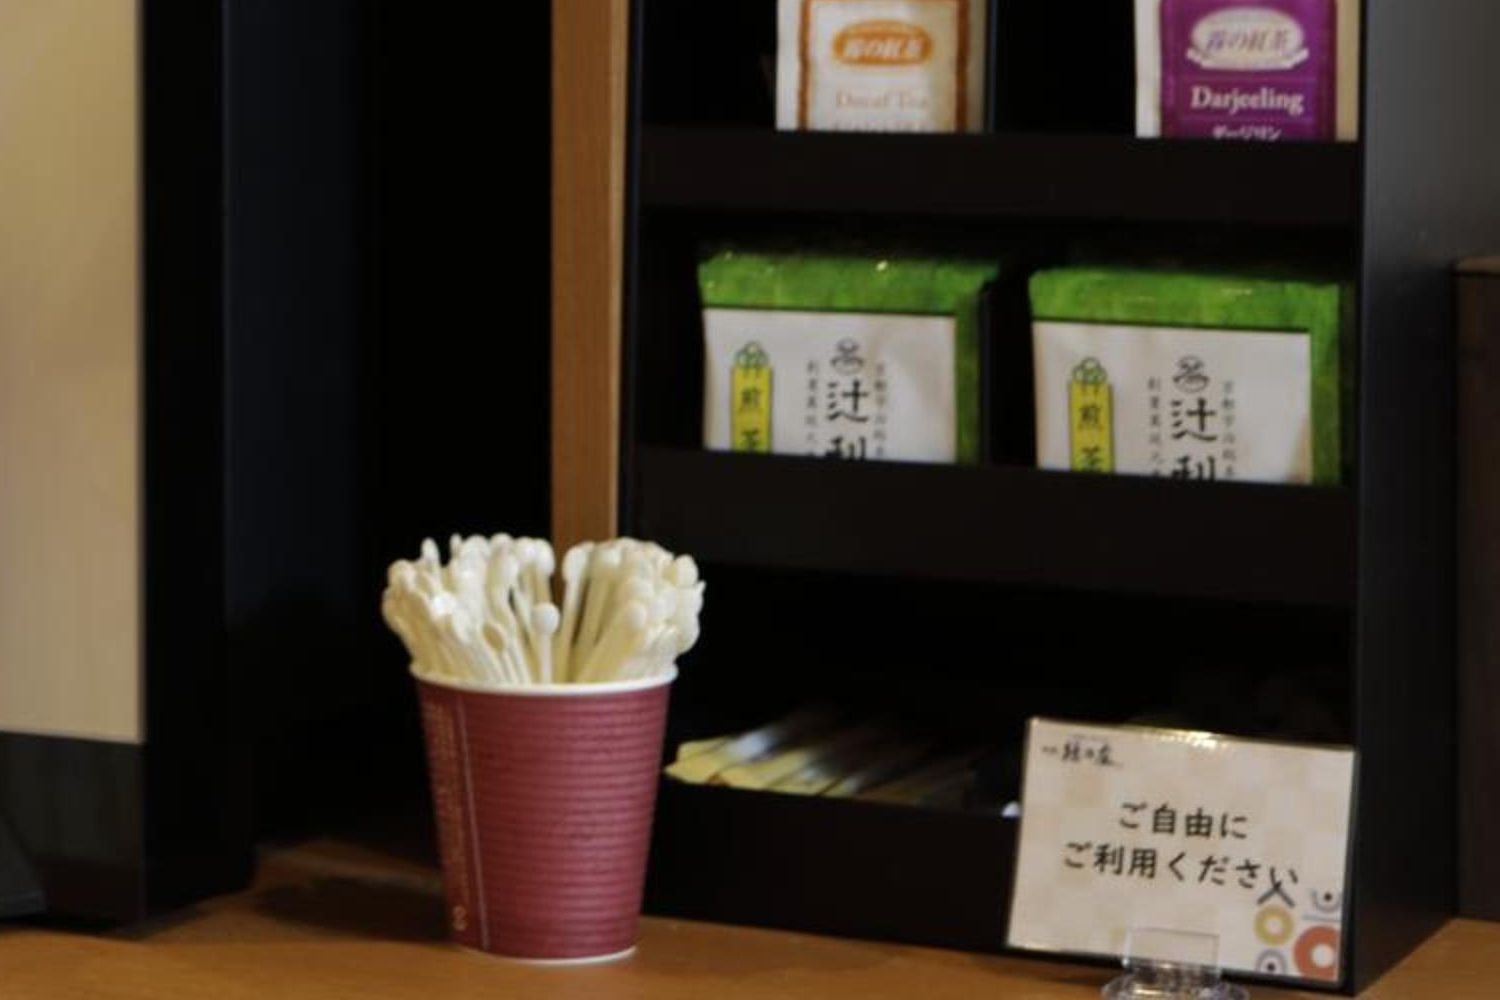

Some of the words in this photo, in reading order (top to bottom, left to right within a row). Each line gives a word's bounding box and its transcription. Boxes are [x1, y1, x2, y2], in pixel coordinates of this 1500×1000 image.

[1190, 85, 1305, 116] Darjeeling
[1169, 397, 1219, 484] 辻利
[1118, 801, 1250, 841] ご自由に
[1063, 841, 1300, 890] ご利用ください
